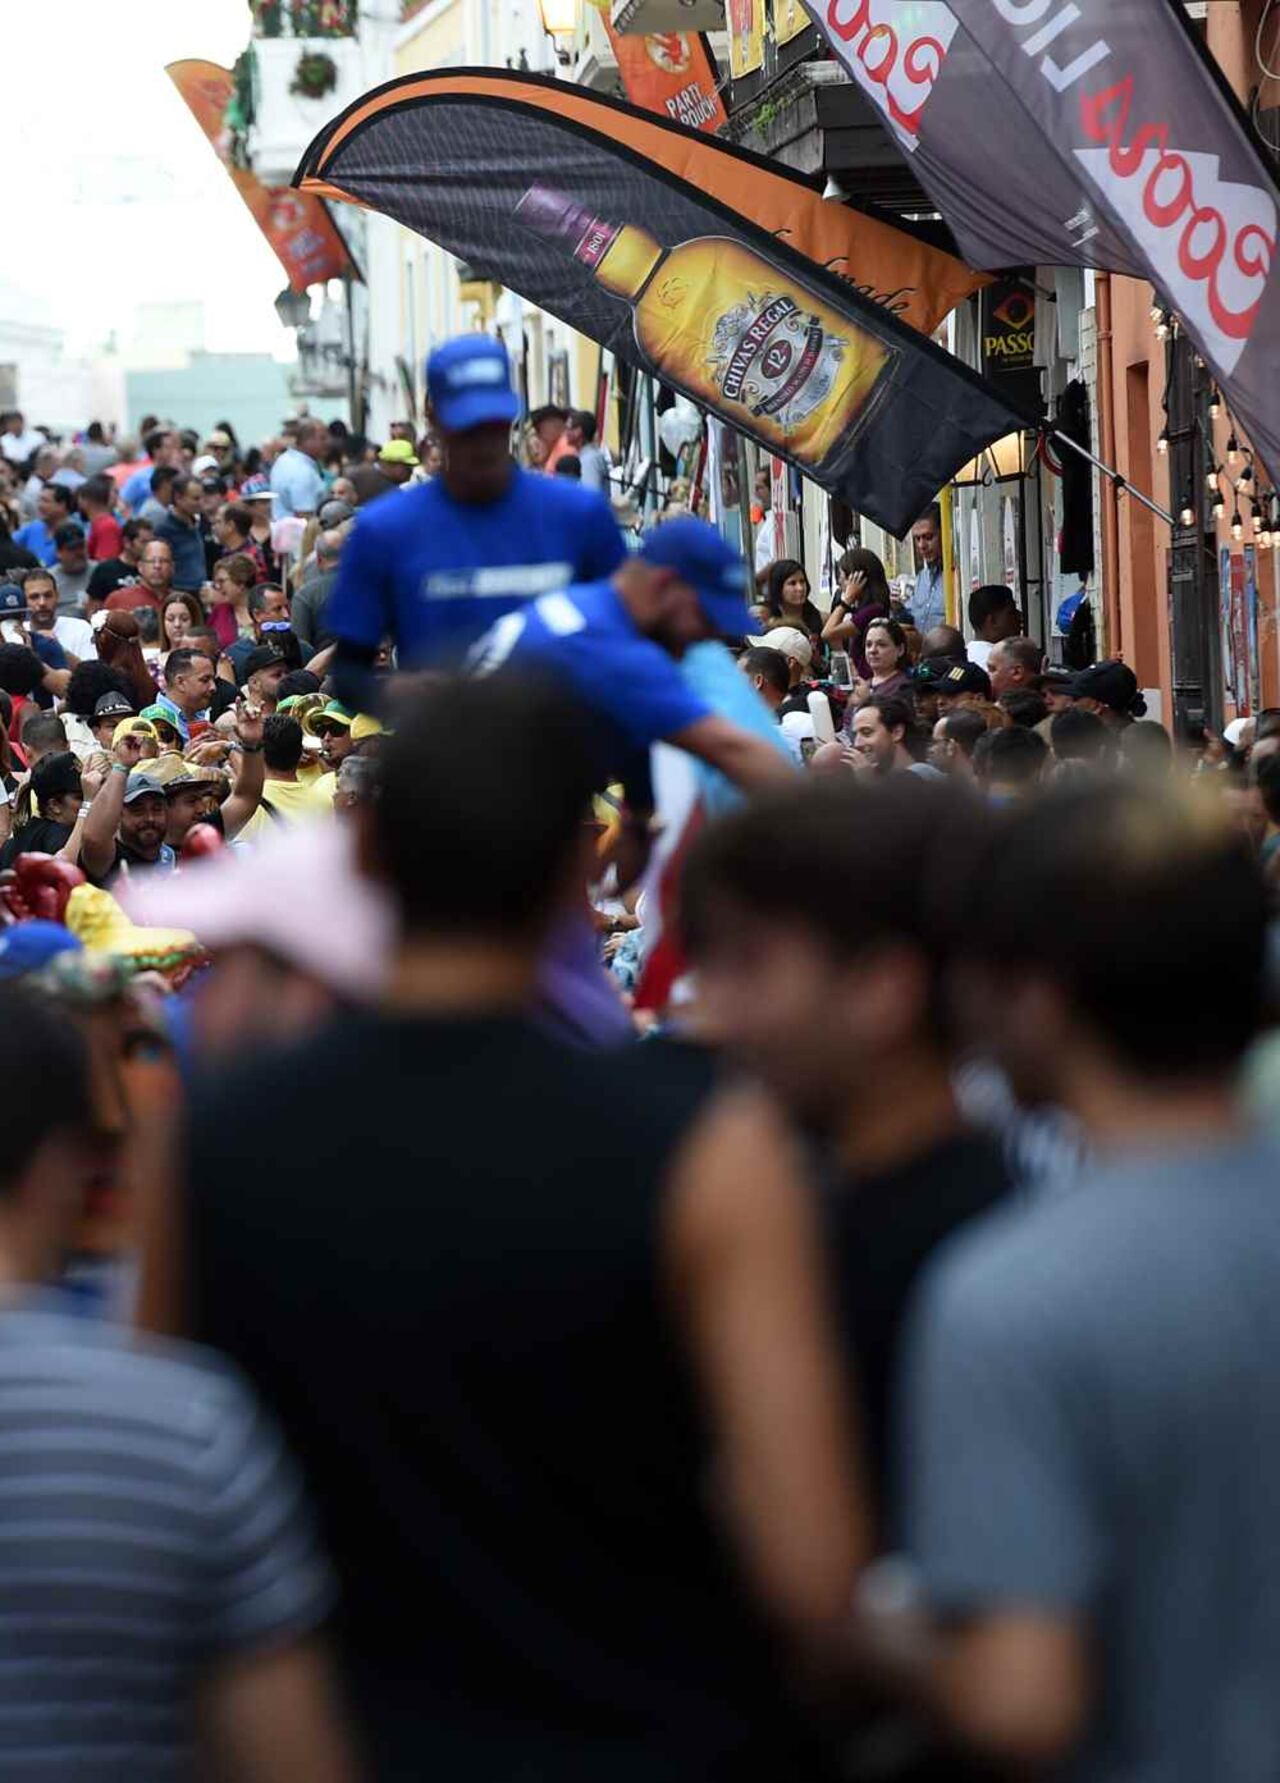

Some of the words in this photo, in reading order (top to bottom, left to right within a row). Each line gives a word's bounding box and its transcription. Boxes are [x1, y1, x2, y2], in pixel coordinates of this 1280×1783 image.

[724, 340, 757, 398] CHIVAS
[750, 299, 794, 341] REGAL
[767, 349, 787, 370] 12
